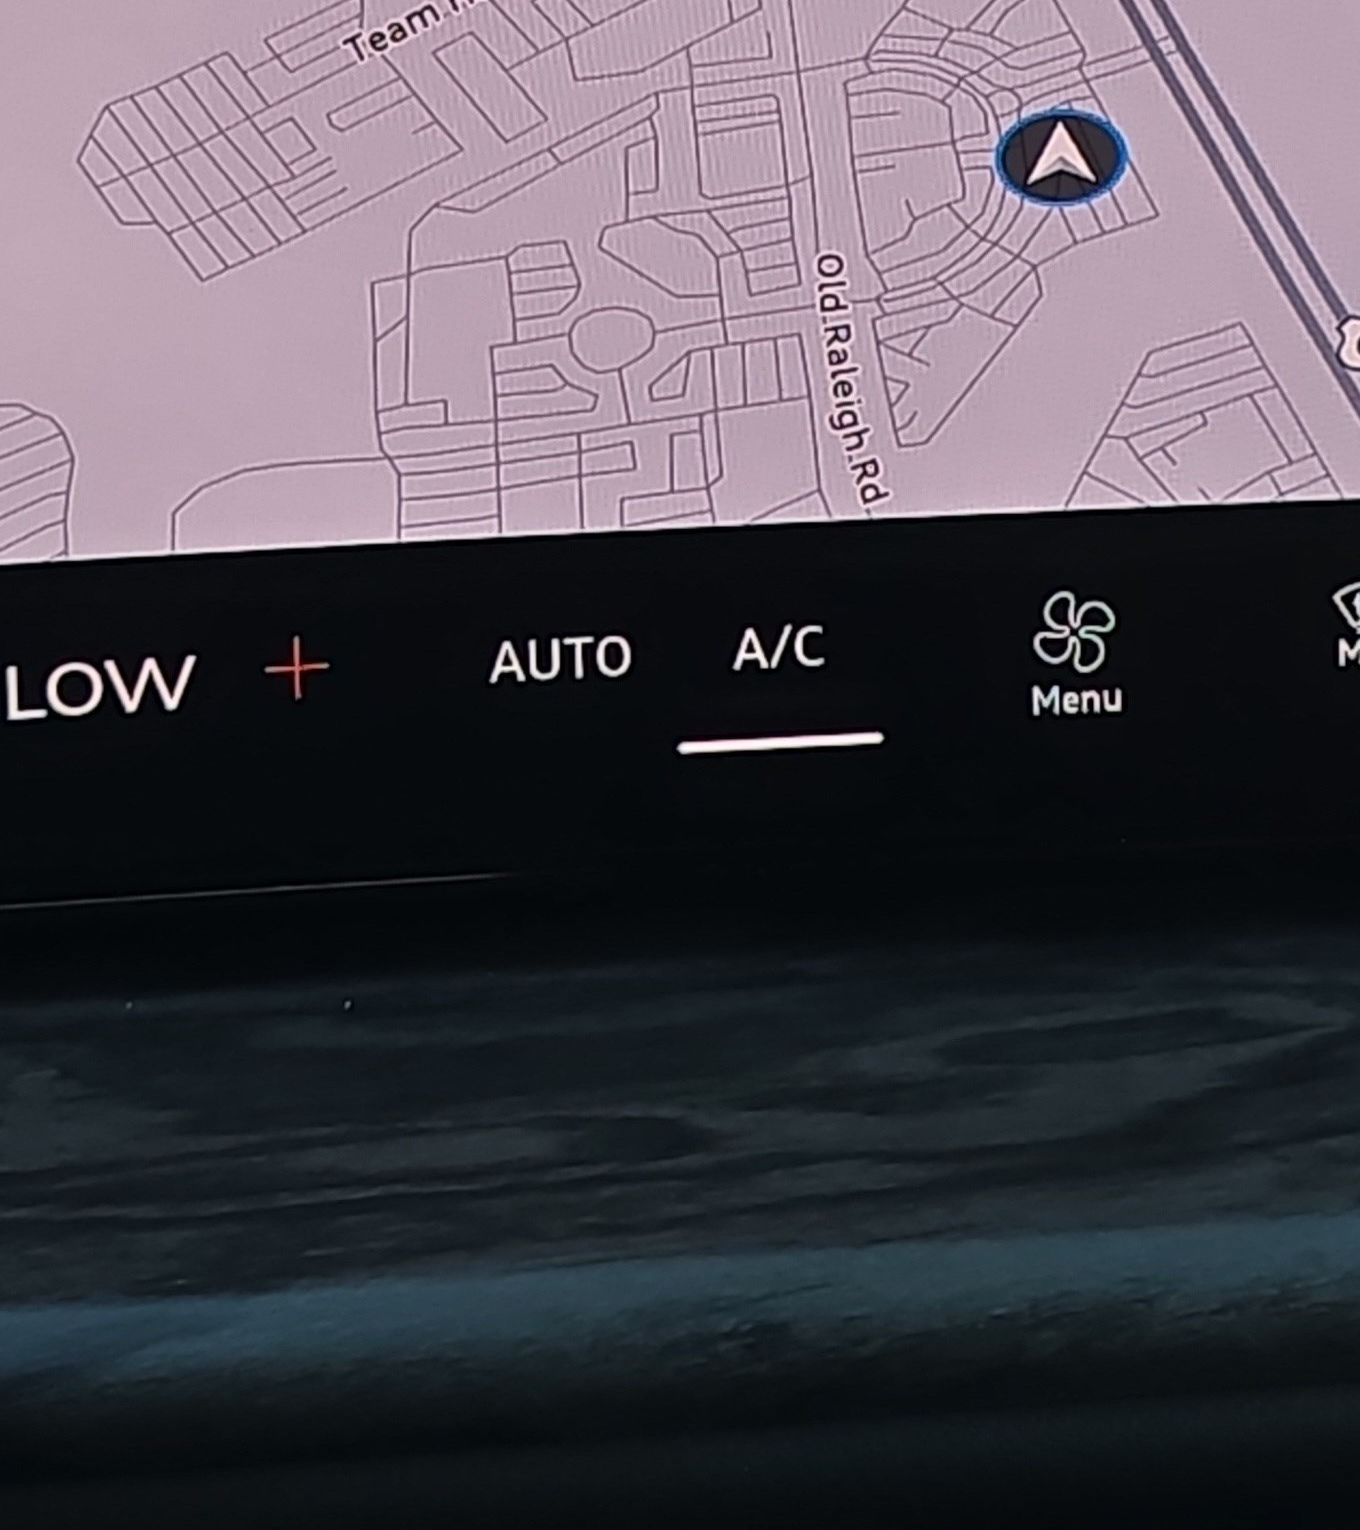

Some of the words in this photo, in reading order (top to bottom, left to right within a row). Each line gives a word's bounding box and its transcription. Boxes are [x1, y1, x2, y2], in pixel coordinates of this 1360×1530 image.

[342, 2, 440, 63] Team
[817, 254, 849, 313] Old
[823, 323, 871, 452] Raleigh
[850, 458, 890, 505] Rd
[489, 634, 633, 684] AUTO
[733, 624, 826, 671] A/C
[4, 654, 197, 721] LOW
[1031, 685, 1123, 717] Menu
